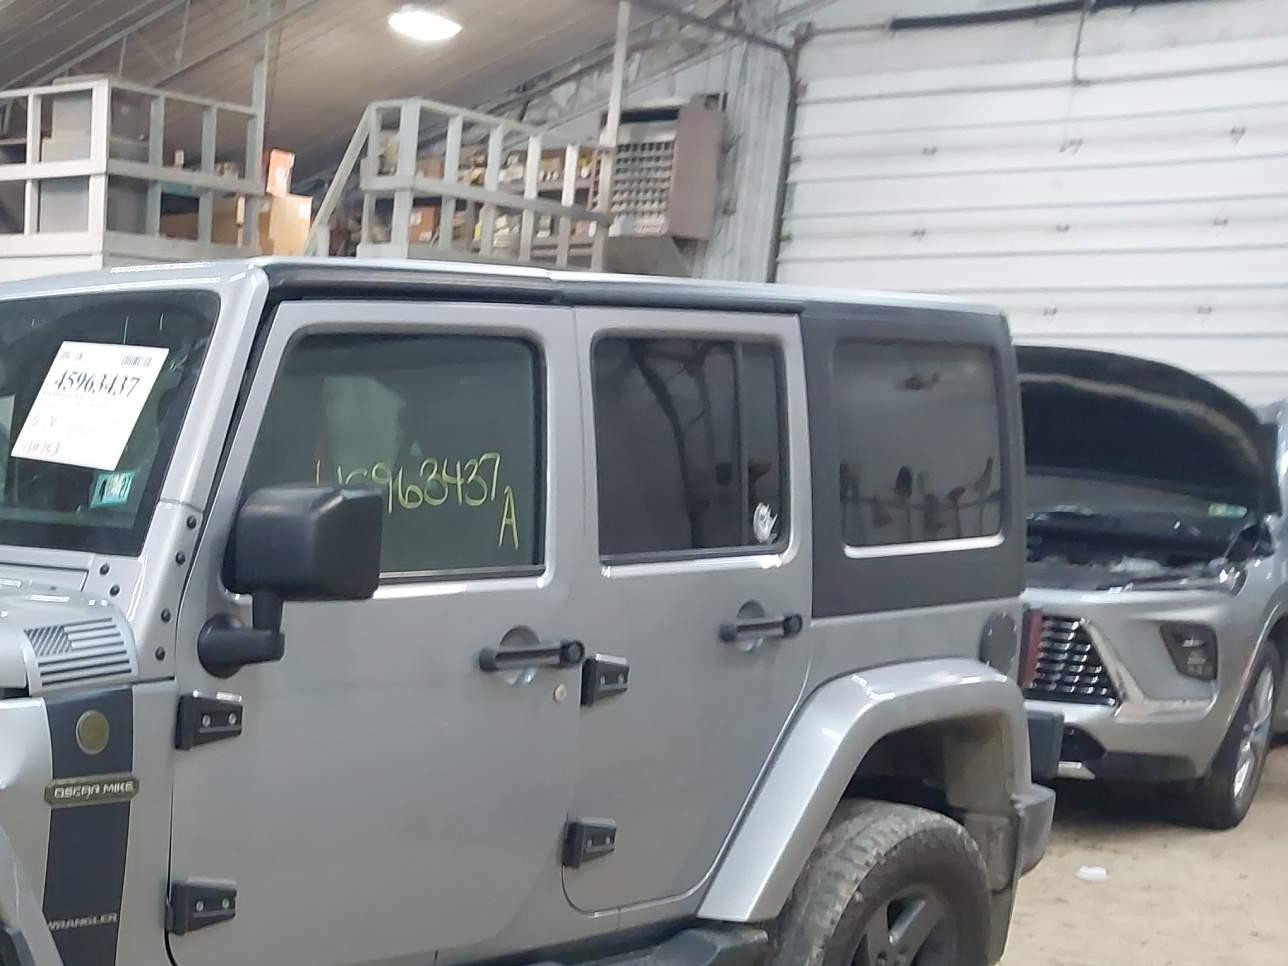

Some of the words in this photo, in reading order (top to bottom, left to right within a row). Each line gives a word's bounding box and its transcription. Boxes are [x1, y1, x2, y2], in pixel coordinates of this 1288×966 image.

[54, 369, 141, 398] 45963437
[498, 485, 519, 550] A
[103, 780, 134, 794] MIKE
